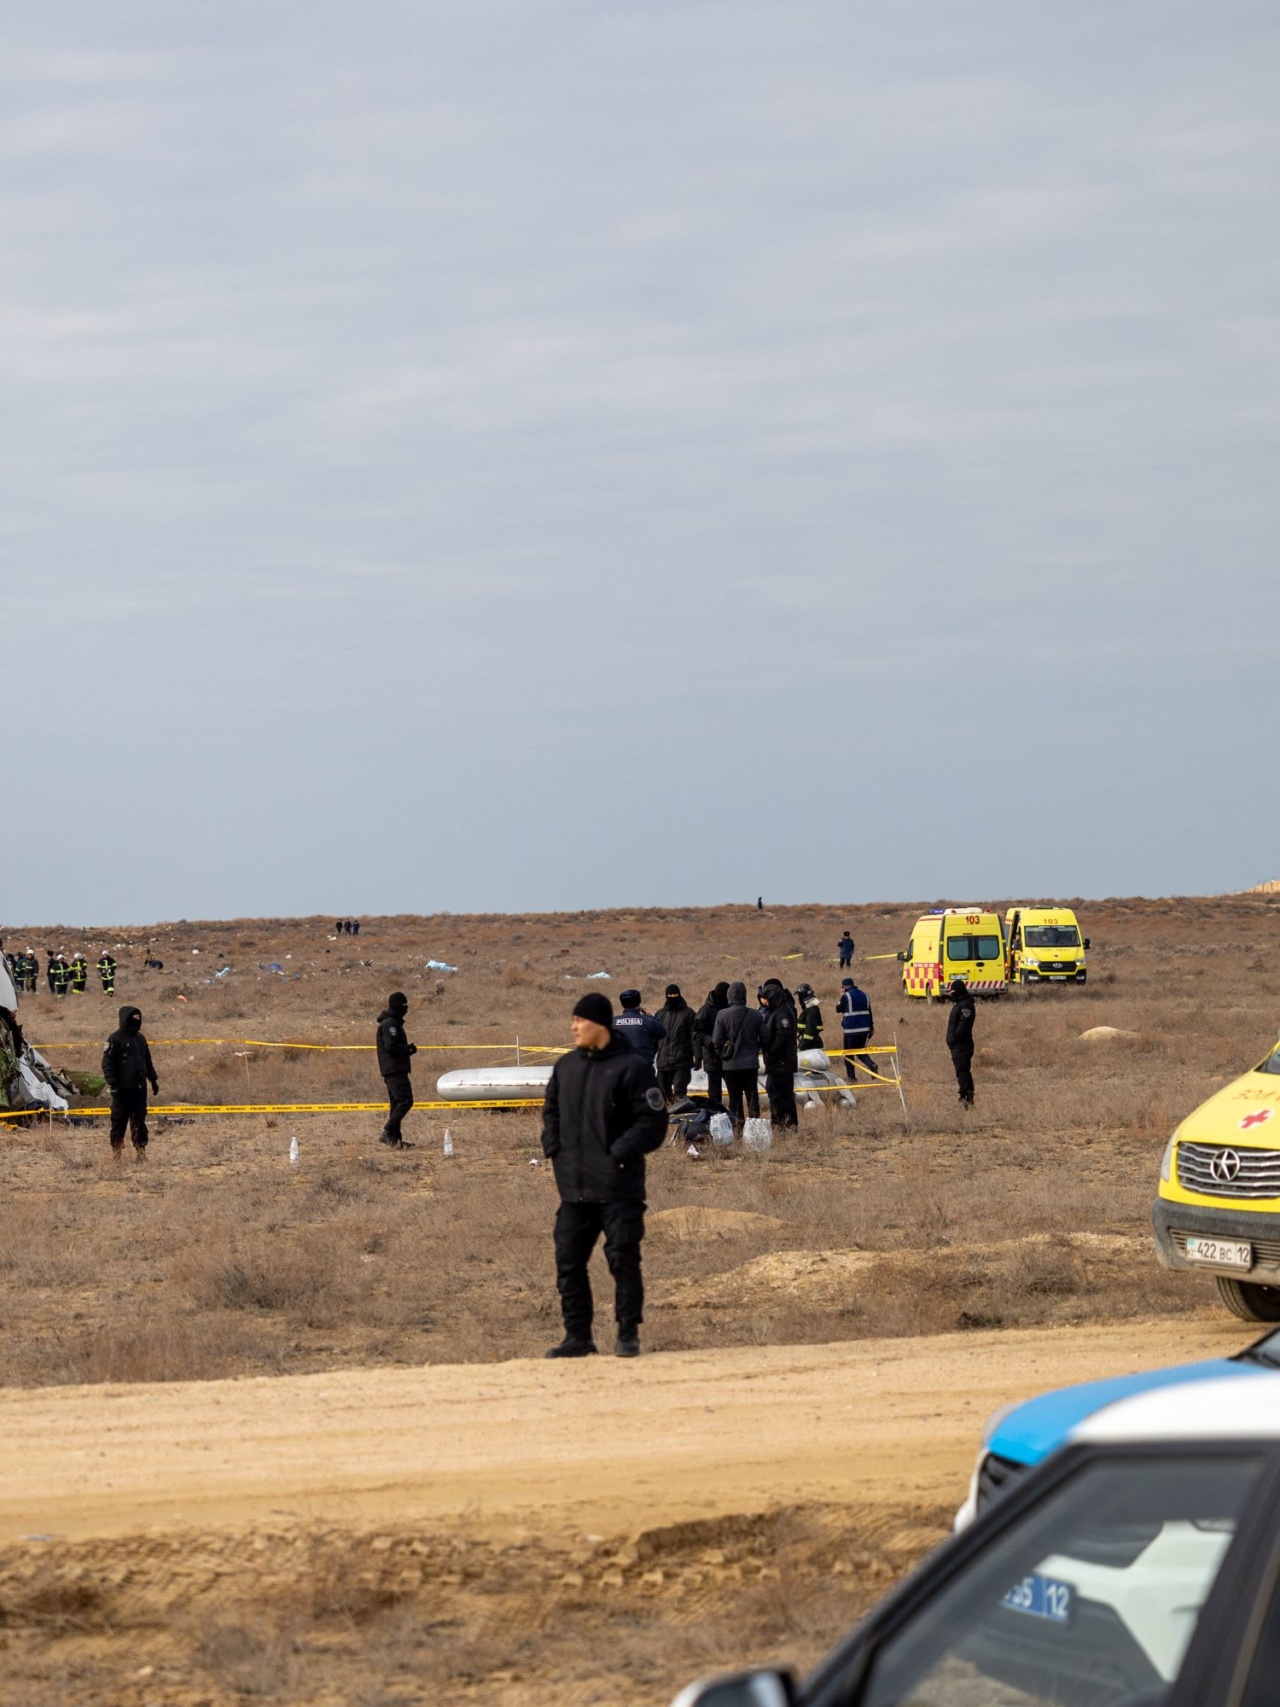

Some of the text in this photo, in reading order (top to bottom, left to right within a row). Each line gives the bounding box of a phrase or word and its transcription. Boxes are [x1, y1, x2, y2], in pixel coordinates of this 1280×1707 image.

[965, 915, 980, 925] 103
[1197, 1242, 1217, 1260] 422
[1219, 1247, 1232, 1261] BC
[1237, 1246, 1250, 1264] 12
[1047, 1583, 1069, 1618] 12
